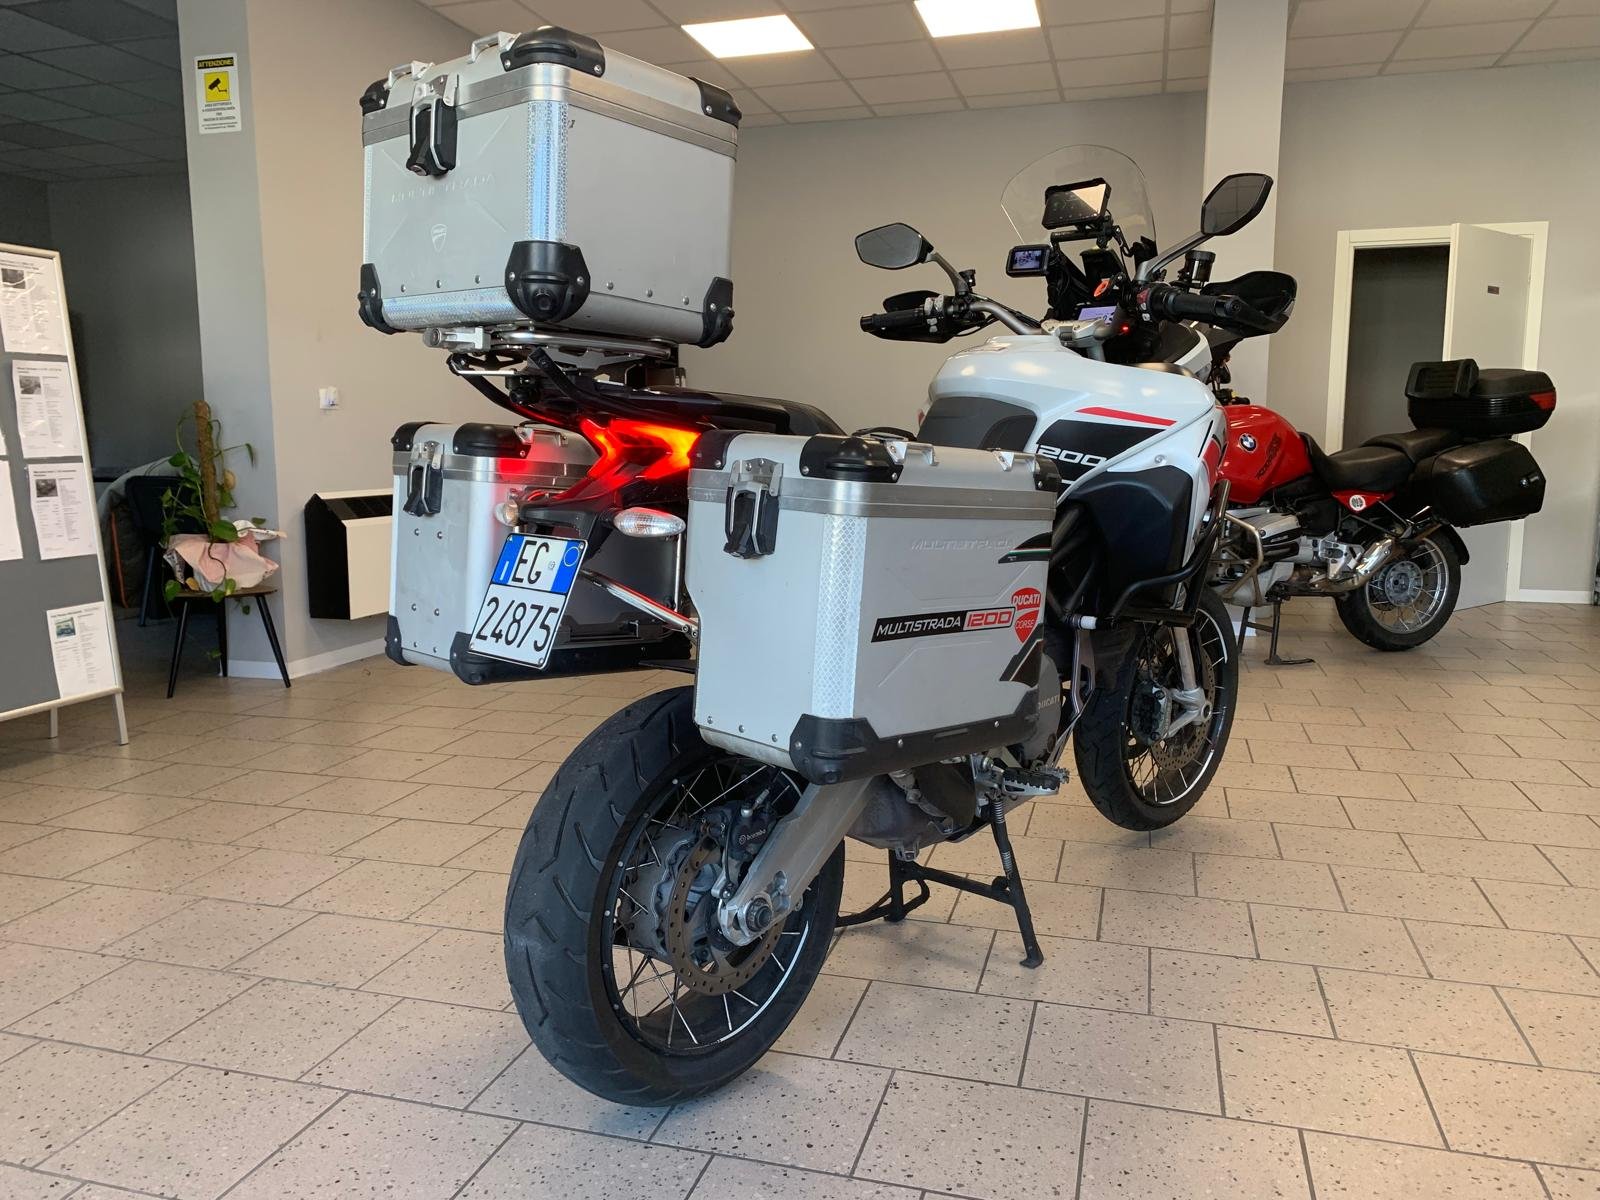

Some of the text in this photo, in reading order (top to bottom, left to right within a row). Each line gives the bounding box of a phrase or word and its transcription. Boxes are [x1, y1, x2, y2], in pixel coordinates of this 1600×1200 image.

[511, 540, 550, 584] EG
[1013, 593, 1041, 606] DUCATI
[475, 596, 560, 653] 24875
[876, 610, 1013, 637] MULTISTRADA 1200
[1015, 619, 1035, 630] CORSE
